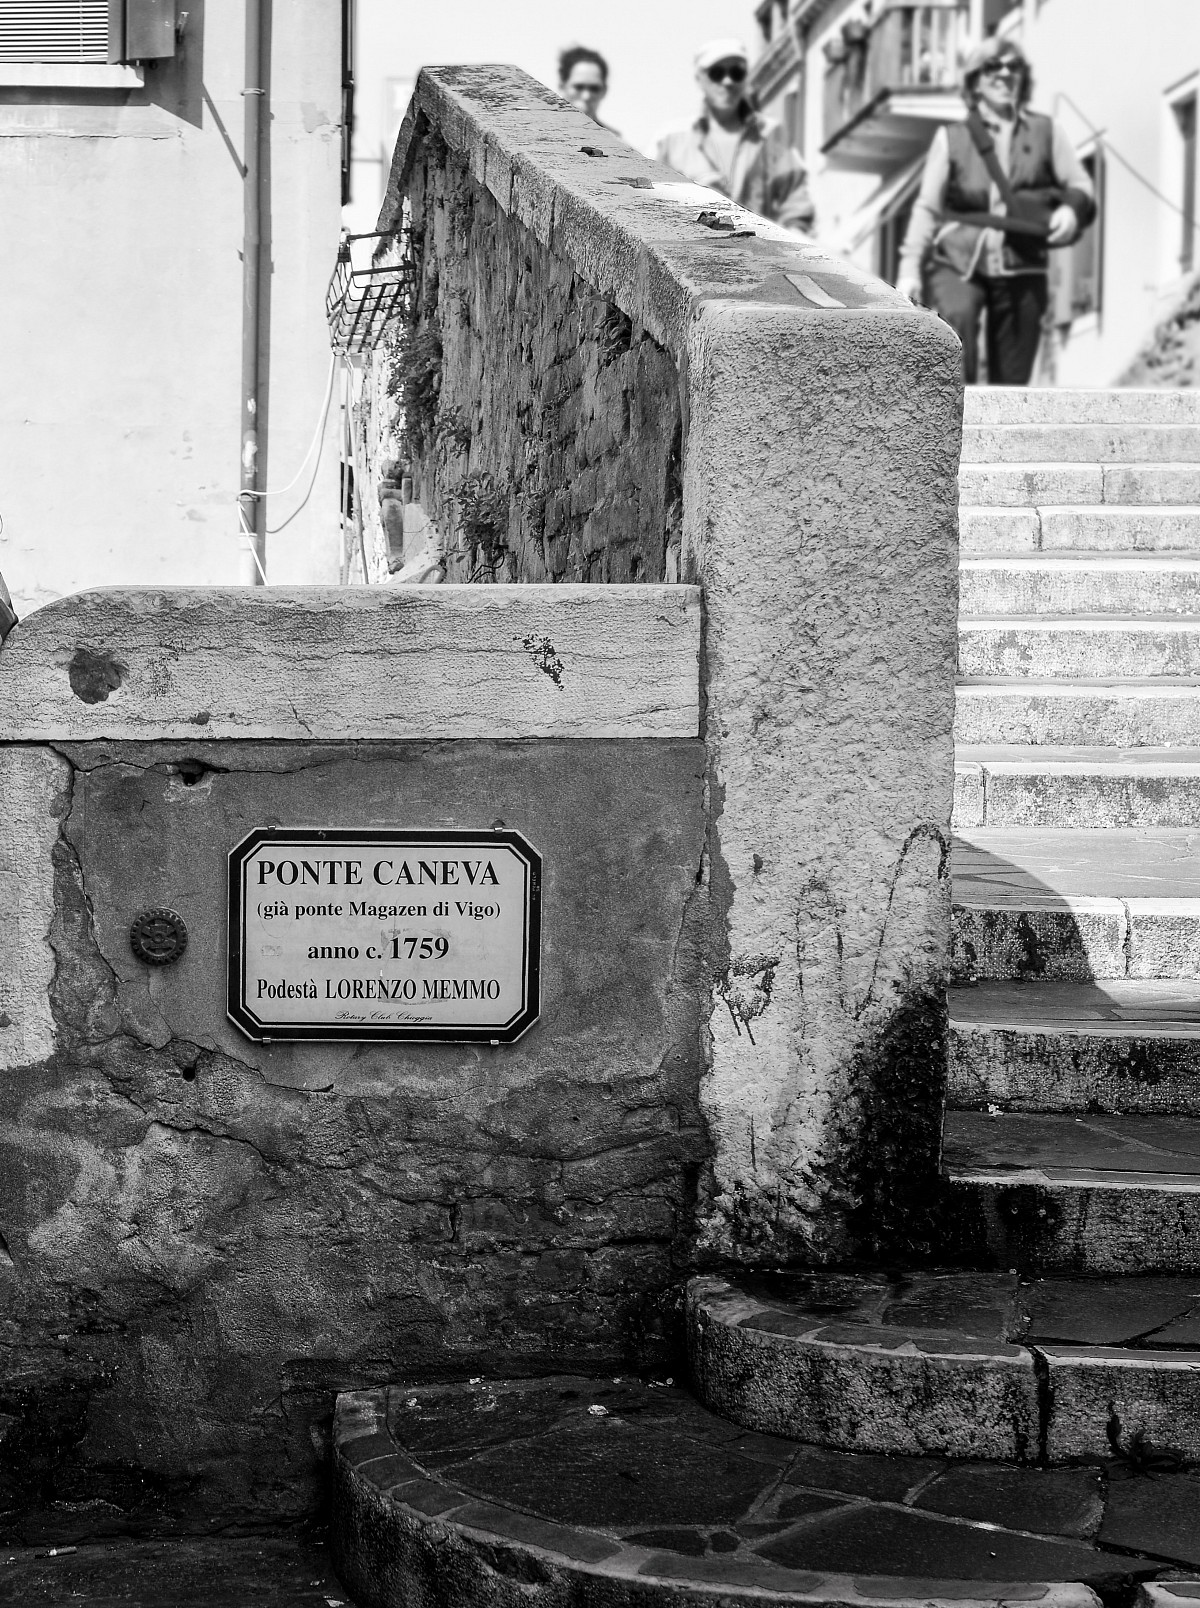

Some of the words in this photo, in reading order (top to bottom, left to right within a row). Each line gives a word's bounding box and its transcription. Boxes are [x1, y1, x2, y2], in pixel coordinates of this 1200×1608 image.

[256, 860, 363, 886] PONTE
[373, 860, 501, 886] CANEVA
[257, 901, 289, 920] (già
[295, 902, 343, 921] ponte
[349, 901, 427, 921] Magazen
[432, 901, 450, 917] di
[454, 901, 501, 921] Vigo)
[307, 945, 360, 960] anno
[365, 945, 383, 960] c.
[390, 936, 450, 960] 1759
[256, 978, 318, 999] Podestà
[324, 979, 417, 1000] LORENZO
[421, 979, 501, 1000] MEMMO
[334, 1010, 367, 1022] Rotary
[369, 1010, 393, 1020] Club
